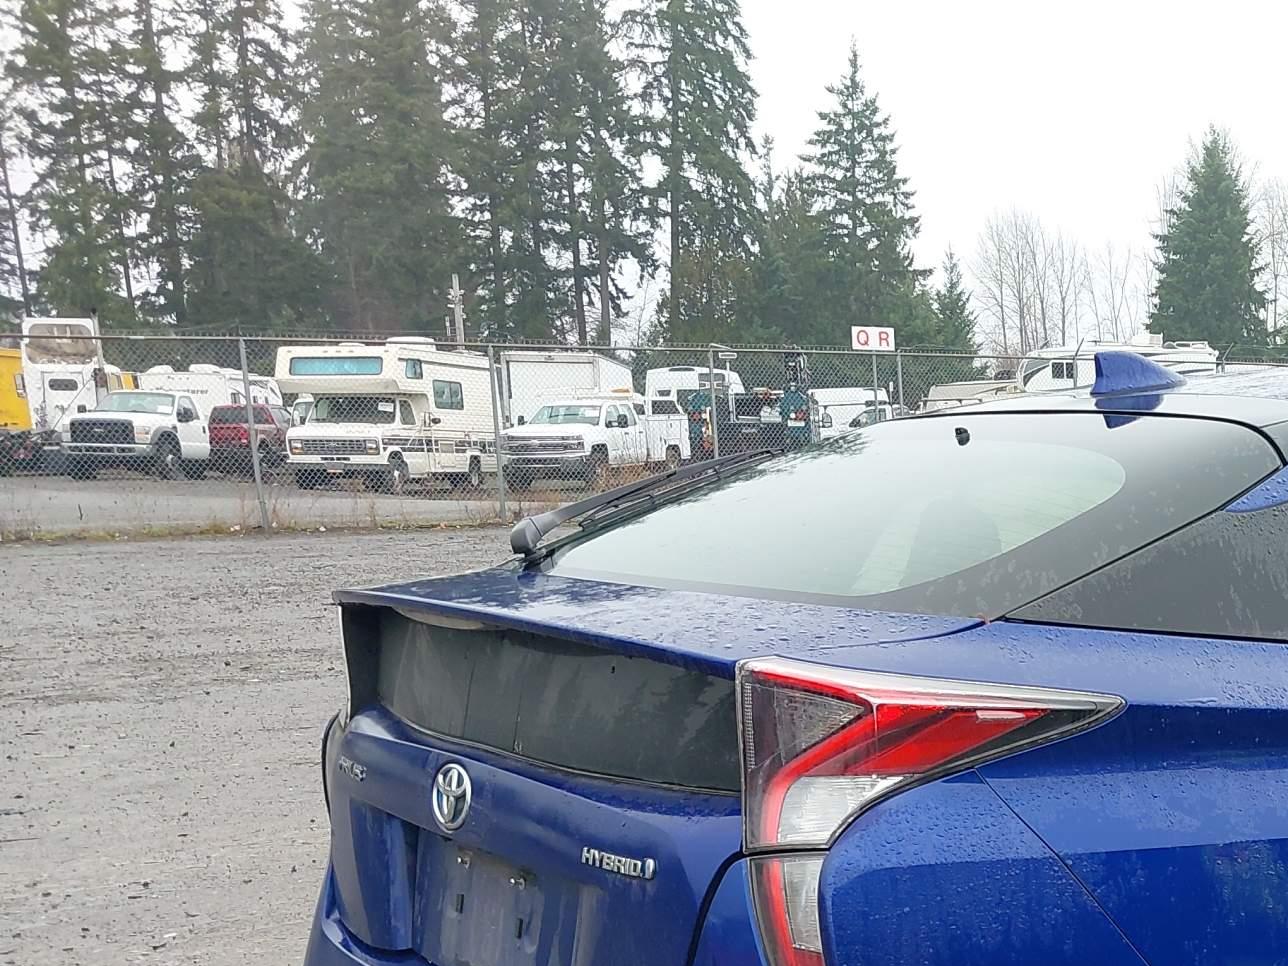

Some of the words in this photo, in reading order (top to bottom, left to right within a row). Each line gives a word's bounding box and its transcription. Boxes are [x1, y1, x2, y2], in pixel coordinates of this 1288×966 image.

[857, 329, 869, 346] Q
[879, 331, 889, 346] R
[581, 846, 643, 878] HYBRID
